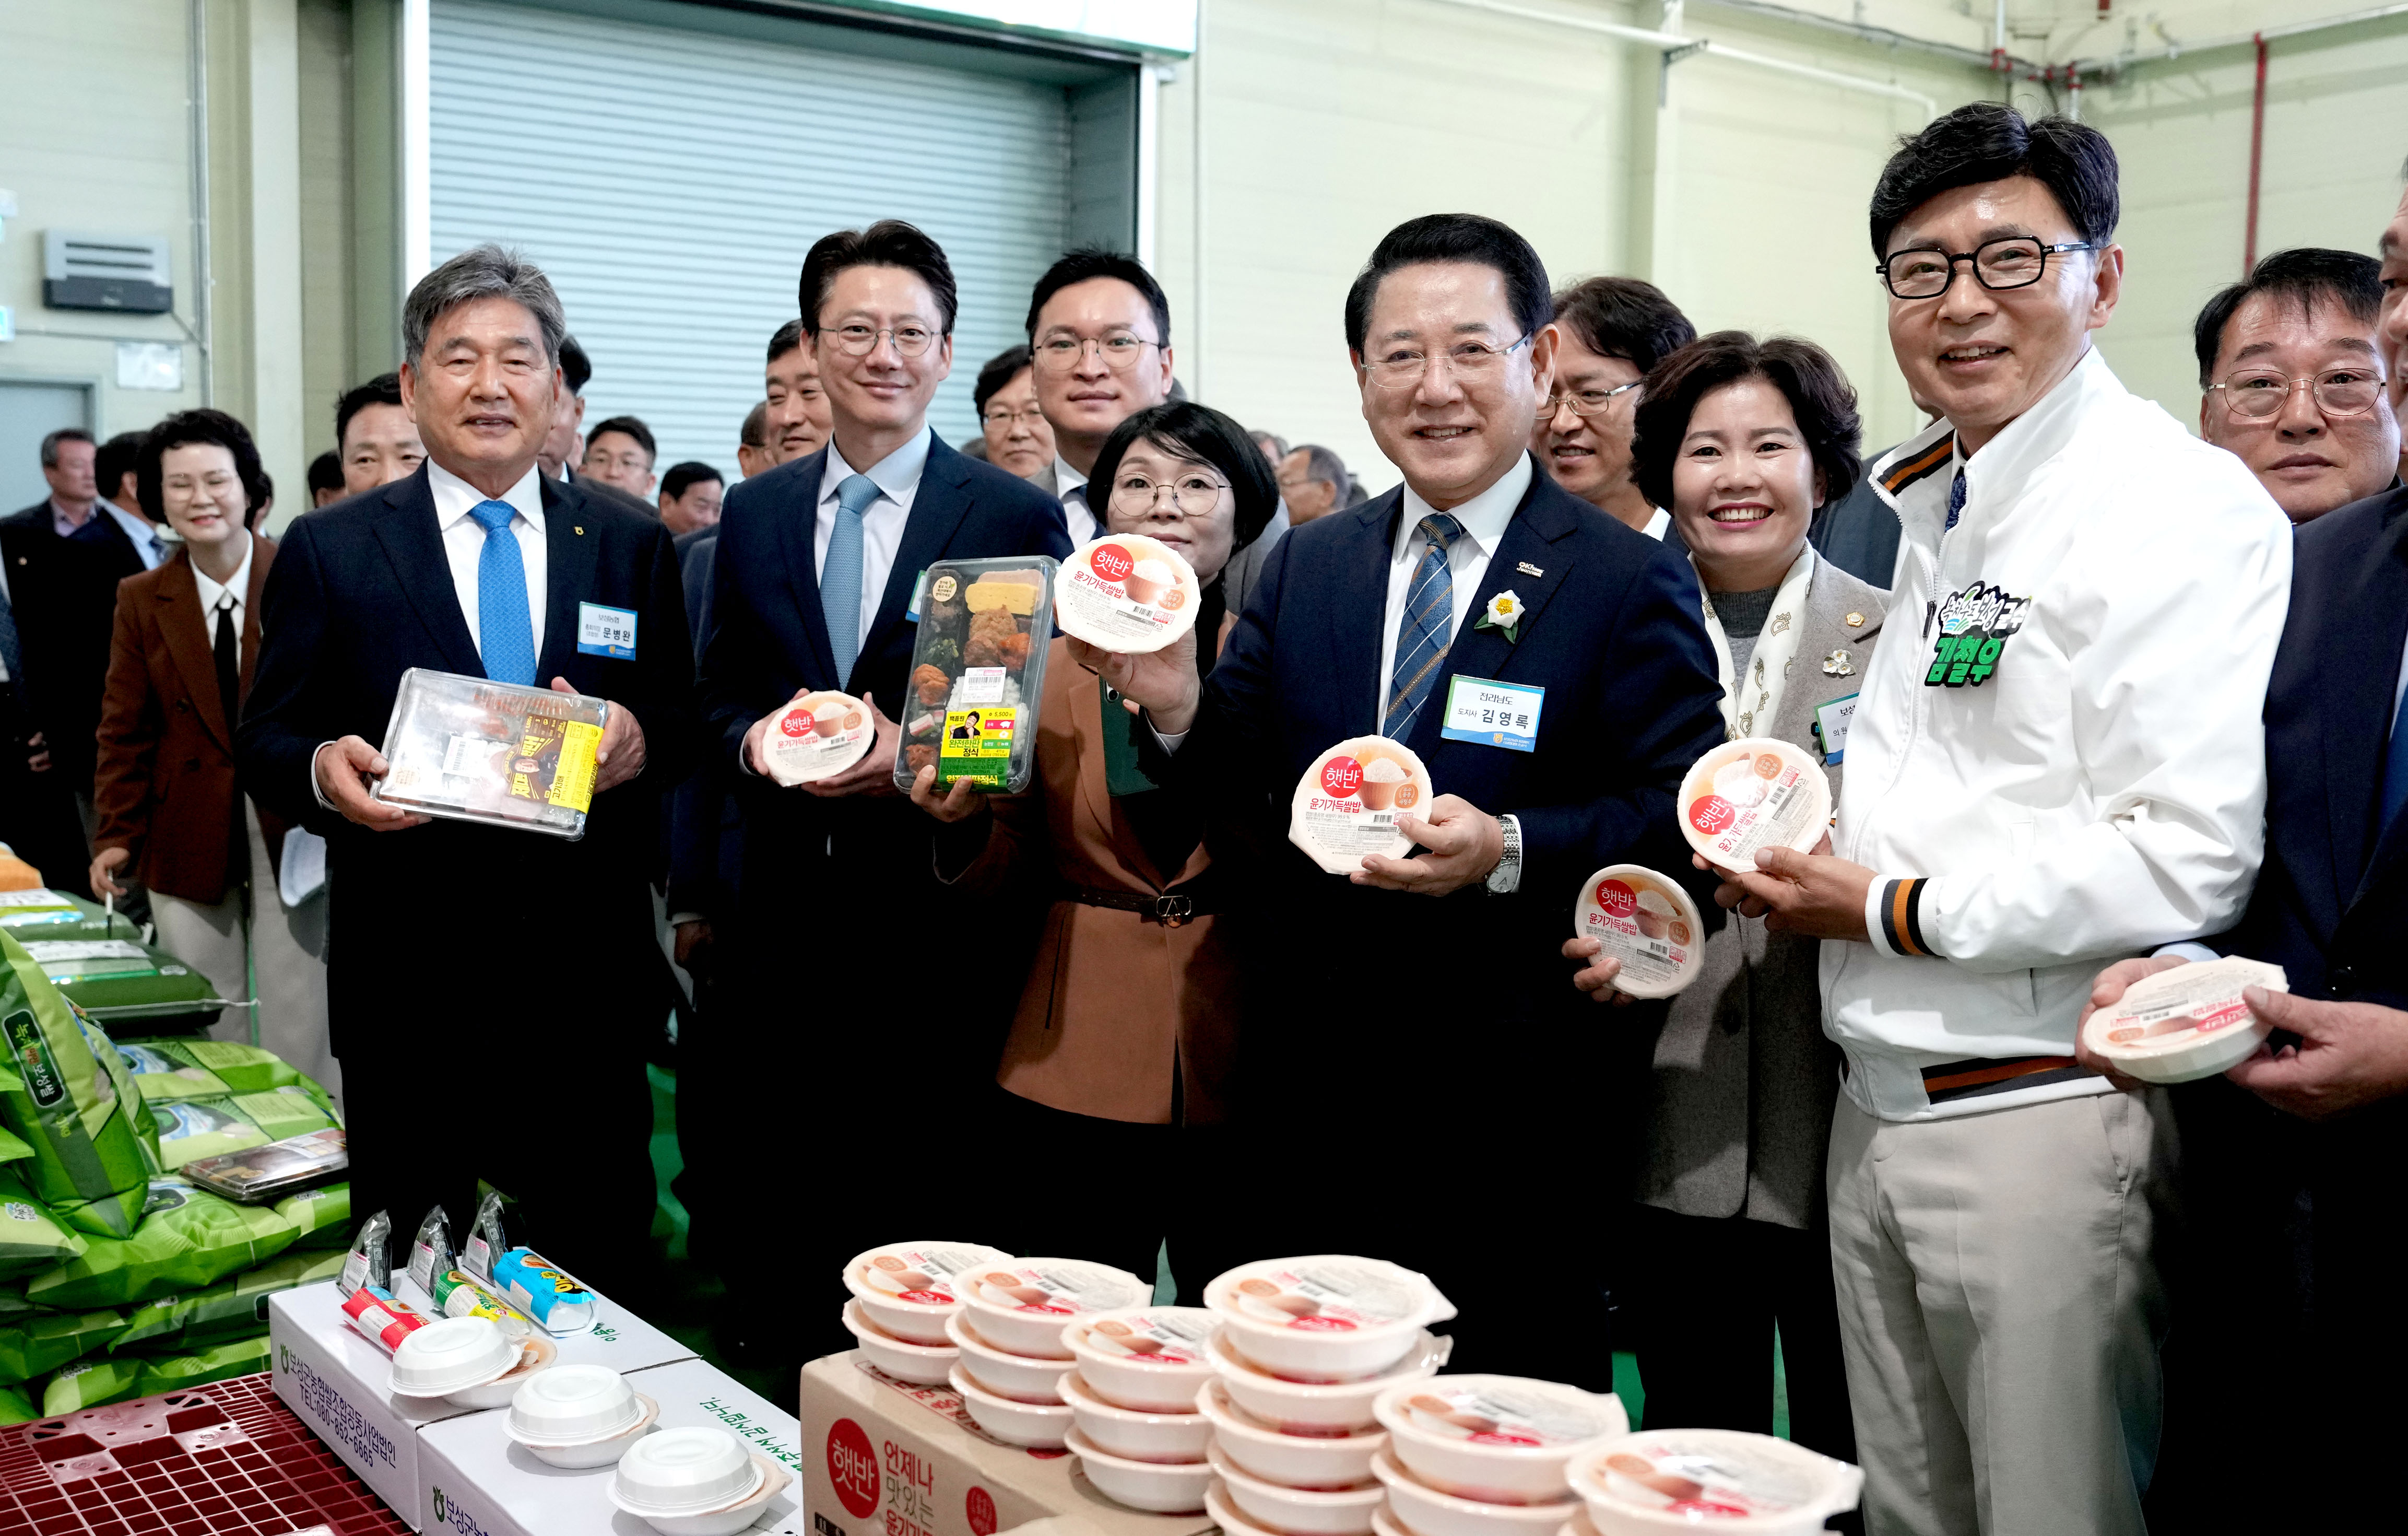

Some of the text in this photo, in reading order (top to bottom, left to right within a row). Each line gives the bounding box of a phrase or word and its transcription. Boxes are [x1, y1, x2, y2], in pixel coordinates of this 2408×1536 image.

[1095, 550, 1130, 577] 햇반
[1073, 570, 1125, 599] 윤기가득쌀밥
[1994, 602, 2027, 630] 군수
[603, 627, 631, 642] 문병완
[1479, 692, 1514, 705] 전라남도
[784, 717, 811, 732] 햇반
[1458, 708, 1528, 729] 도지사 김영록
[778, 735, 818, 748] 윤기가득쌀밥
[949, 740, 980, 748] 완전한판
[963, 748, 979, 757] 정식
[552, 775, 564, 800] 고기3배
[946, 775, 998, 785] 완전판정식
[1326, 767, 1359, 789] 햇반
[1309, 798, 1361, 813] 윤기가득쌀밥
[1695, 799, 1729, 832] 햇반
[1601, 887, 1634, 911] 햇반
[1589, 913, 1638, 935] 윤기가득쌀밥
[32, 1062, 56, 1099] 보성쌀
[832, 1438, 875, 1502] 햇반
[884, 1440, 934, 1496] 언제나
[887, 1475, 934, 1528] 맛있는
